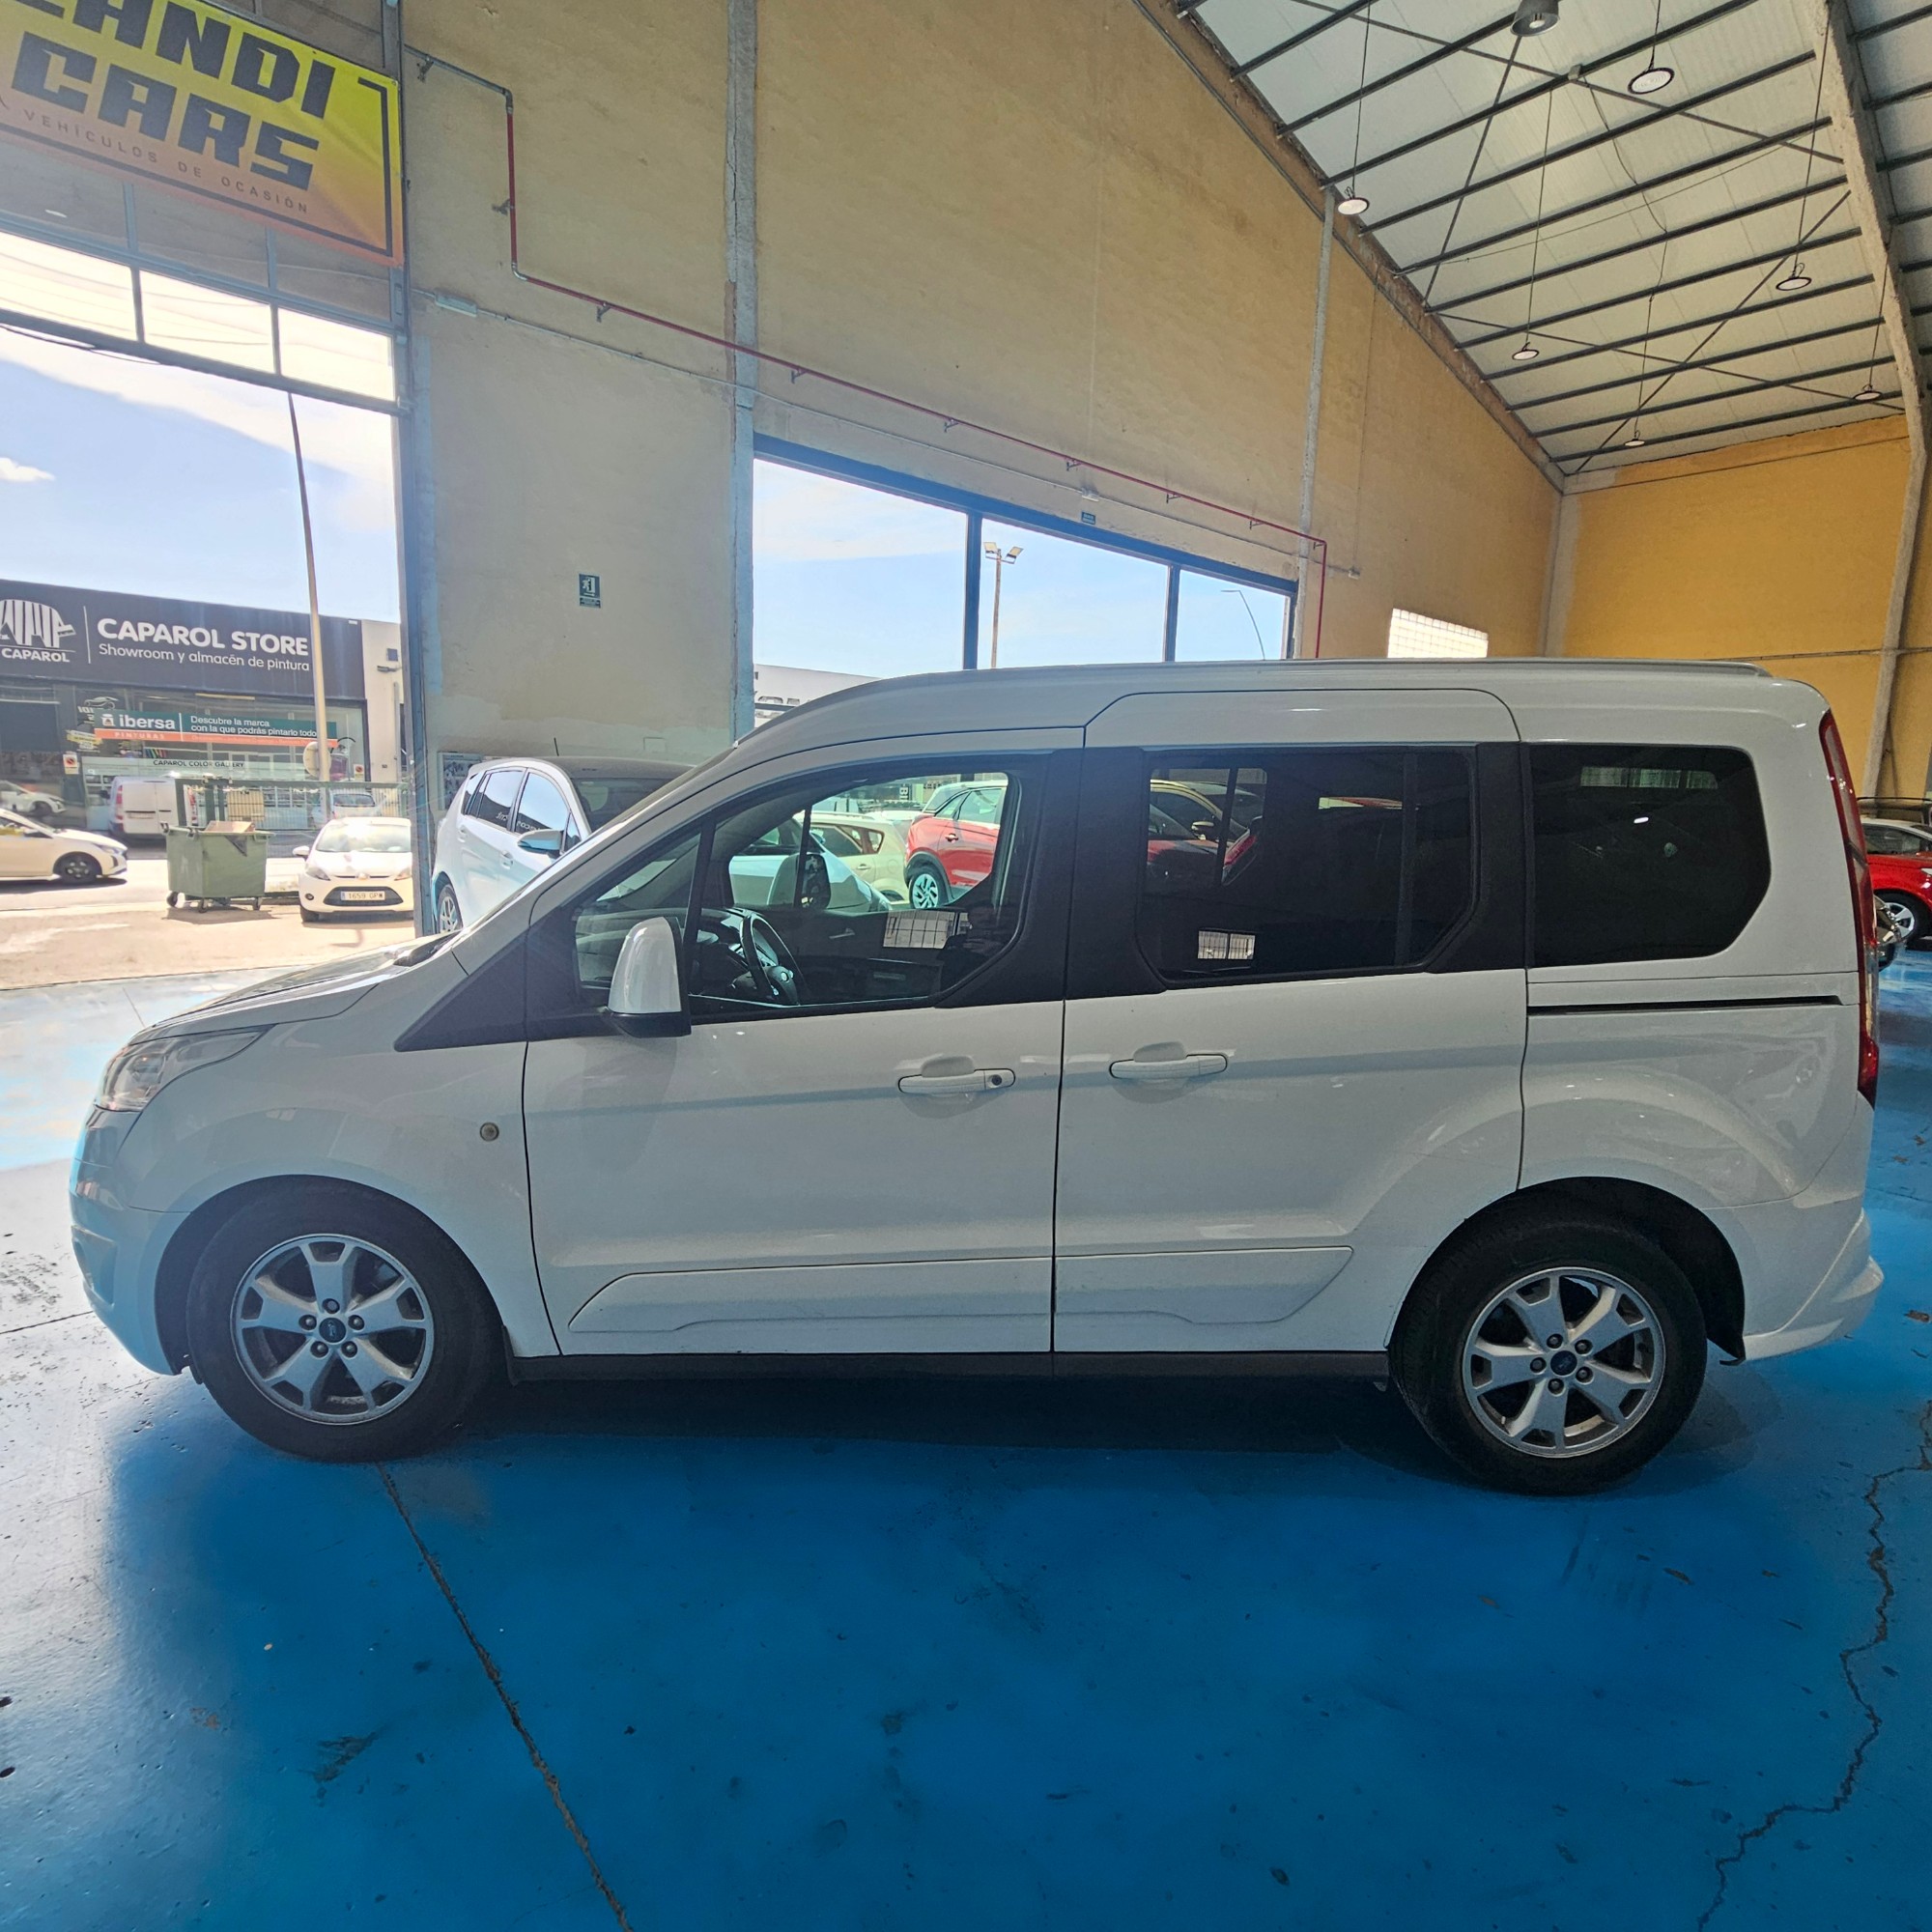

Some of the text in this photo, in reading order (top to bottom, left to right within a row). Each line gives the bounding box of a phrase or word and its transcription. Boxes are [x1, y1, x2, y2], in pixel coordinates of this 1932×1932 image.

[15, 0, 335, 119] ANDI
[12, 31, 320, 190] CARS
[178, 159, 202, 179] DE
[220, 175, 308, 213] OCASIÓN
[97, 617, 309, 656] CAPAROL STORE
[1, 647, 71, 663] CAPAROL
[99, 642, 310, 671] Showroom y almacén de pintura
[119, 713, 176, 730] ibersa
[190, 715, 270, 727] Descubre la marca
[209, 724, 218, 733] la
[219, 726, 237, 736] que
[237, 727, 267, 736] podrás
[268, 728, 298, 737] pintarlo
[114, 731, 165, 740] PINTURAS
